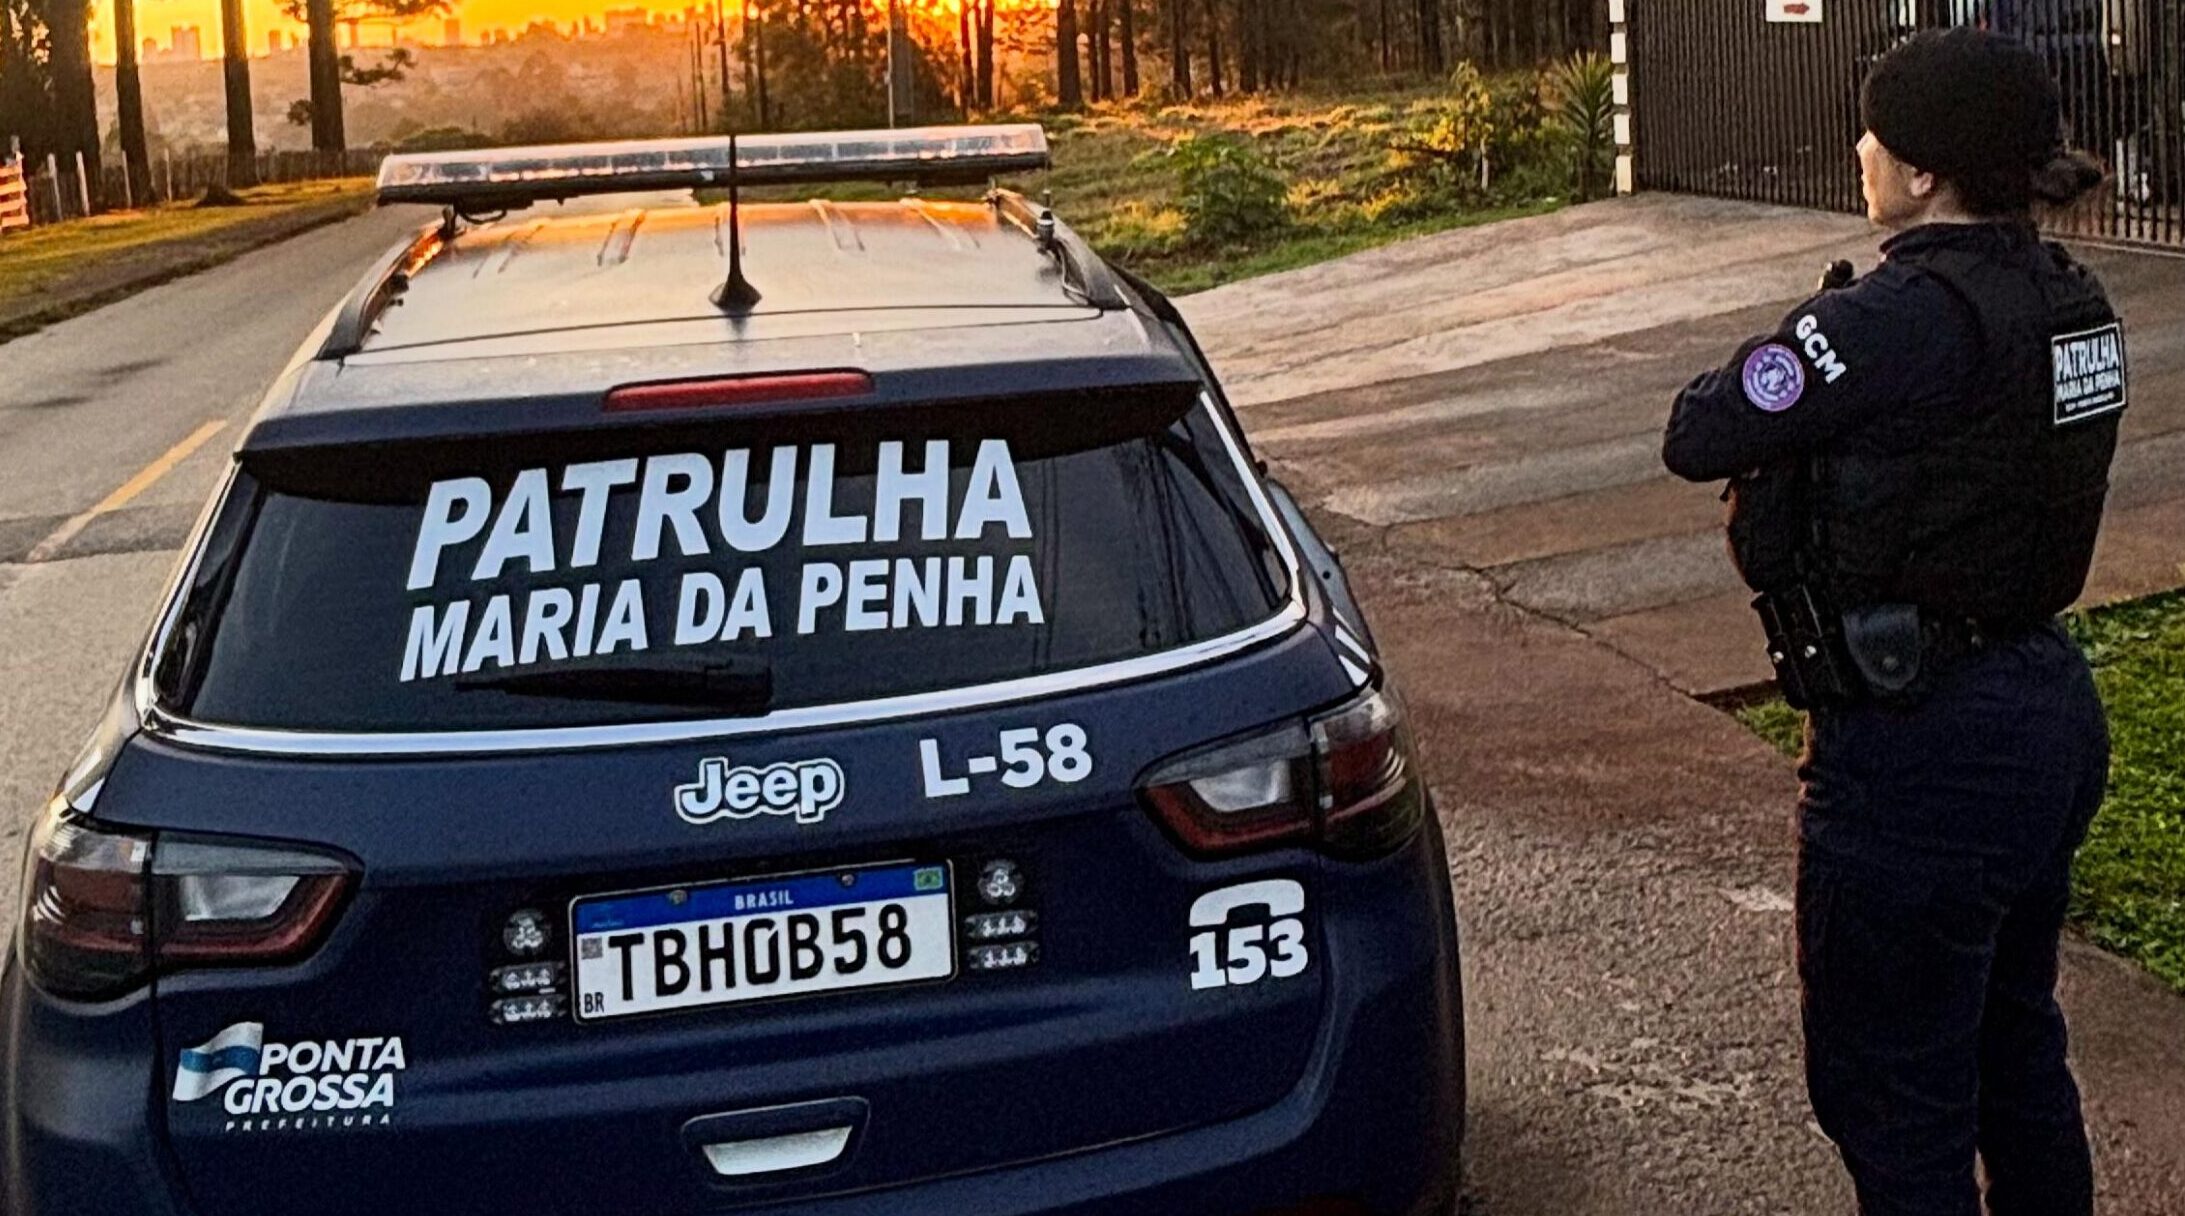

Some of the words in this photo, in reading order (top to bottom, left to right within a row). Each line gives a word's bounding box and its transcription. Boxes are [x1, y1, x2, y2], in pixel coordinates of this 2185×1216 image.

[1795, 314, 1847, 384] GCM
[2054, 333, 2119, 382] PATRULHA
[406, 439, 1033, 590] PATRULHA
[400, 579, 649, 682] MARIA
[674, 566, 772, 646] DA
[797, 555, 1045, 635] PENHA
[919, 723, 1093, 798] L-58
[674, 757, 846, 825] Jeep
[734, 890, 795, 912] BRASIL
[1189, 918, 1309, 990] 153
[584, 991, 606, 1014] BR
[259, 1036, 406, 1075] PONTA
[224, 1073, 394, 1115] GROSSA
[225, 1113, 391, 1132] PREFEITURA
